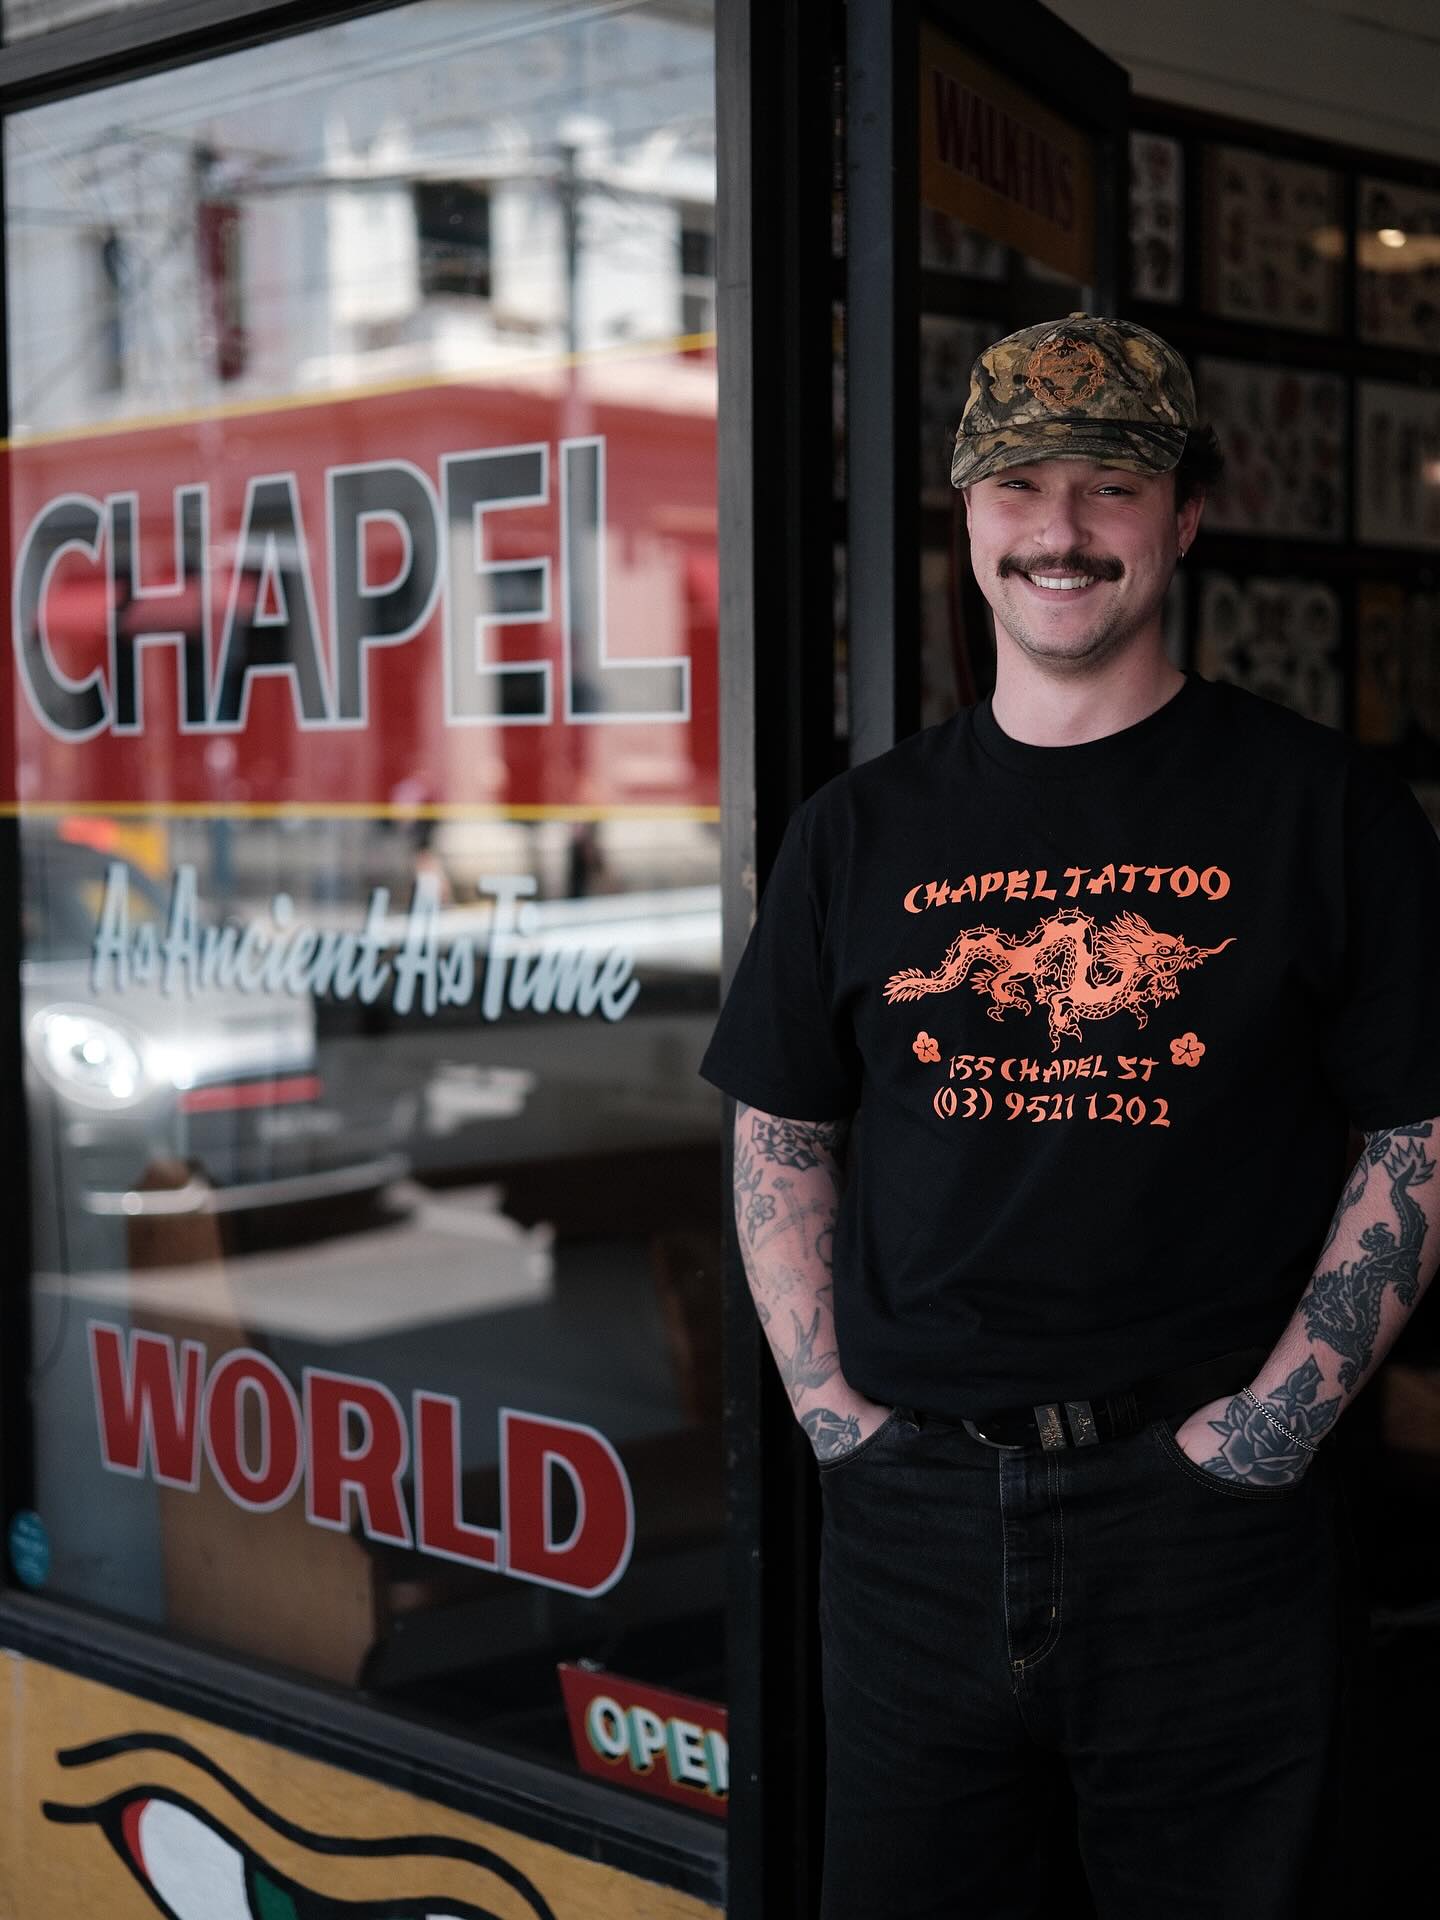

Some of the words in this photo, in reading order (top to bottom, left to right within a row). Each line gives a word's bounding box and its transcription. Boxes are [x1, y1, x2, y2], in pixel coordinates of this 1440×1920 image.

[13, 436, 690, 743] CHAPEL
[903, 869, 1057, 913] CHAPEL
[1064, 863, 1231, 901] TATTOO
[90, 861, 157, 996] As
[162, 863, 391, 1005] Ancient
[393, 870, 476, 1017] As
[479, 874, 641, 1022] Time
[933, 1087, 993, 1121] (03)
[1004, 1092, 1076, 1123] 9521
[1085, 1092, 1171, 1128] 1202
[949, 1054, 996, 1081] 155
[1000, 1054, 1108, 1083] CHAPEL
[1117, 1055, 1160, 1082] ST
[87, 1320, 636, 1599] WORLD
